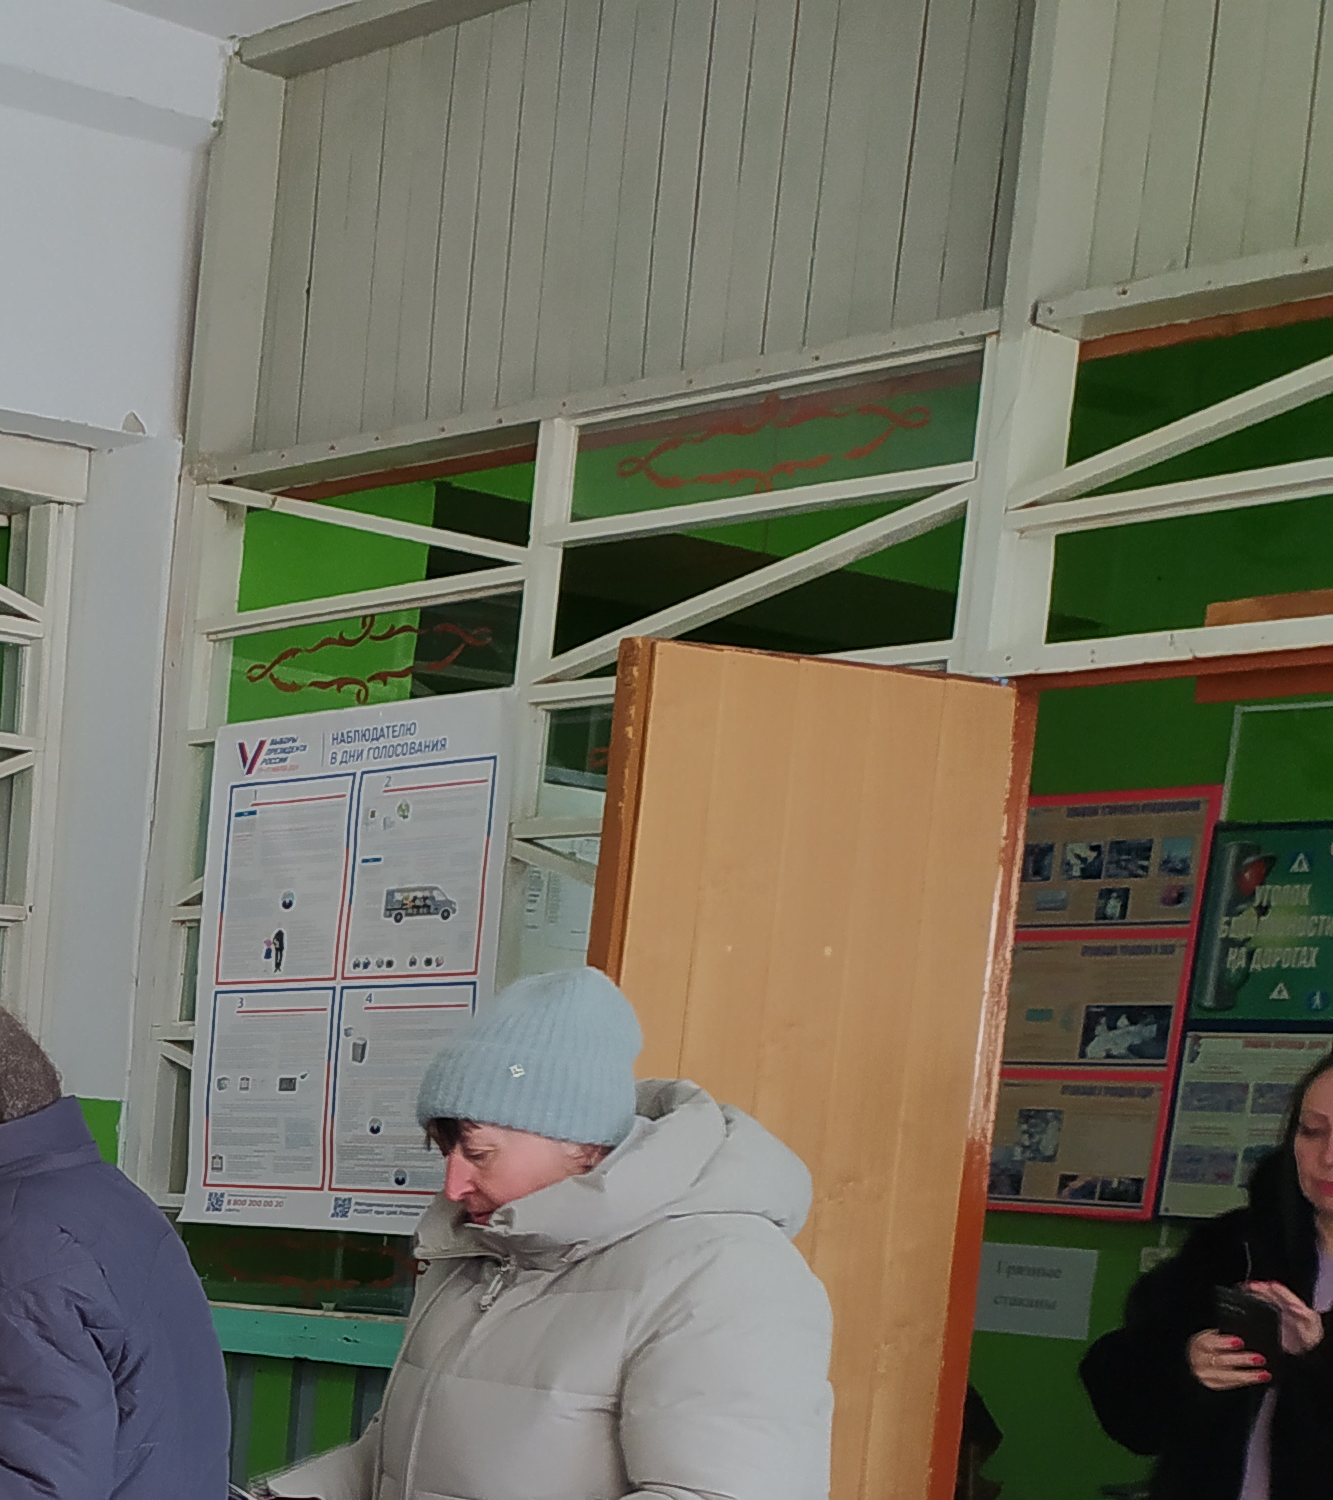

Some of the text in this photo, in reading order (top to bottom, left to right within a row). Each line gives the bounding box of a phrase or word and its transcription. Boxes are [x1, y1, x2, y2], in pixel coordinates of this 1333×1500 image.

[331, 722, 417, 745] НАБЛЮДАТЕЛЮ
[329, 738, 448, 766] В ДНИ ГОЛОСОВАНИЯ
[384, 776, 393, 788] 2
[1226, 946, 1319, 972] НА ДОРОГАХ
[237, 997, 244, 1009] 3
[365, 992, 373, 1004] 4
